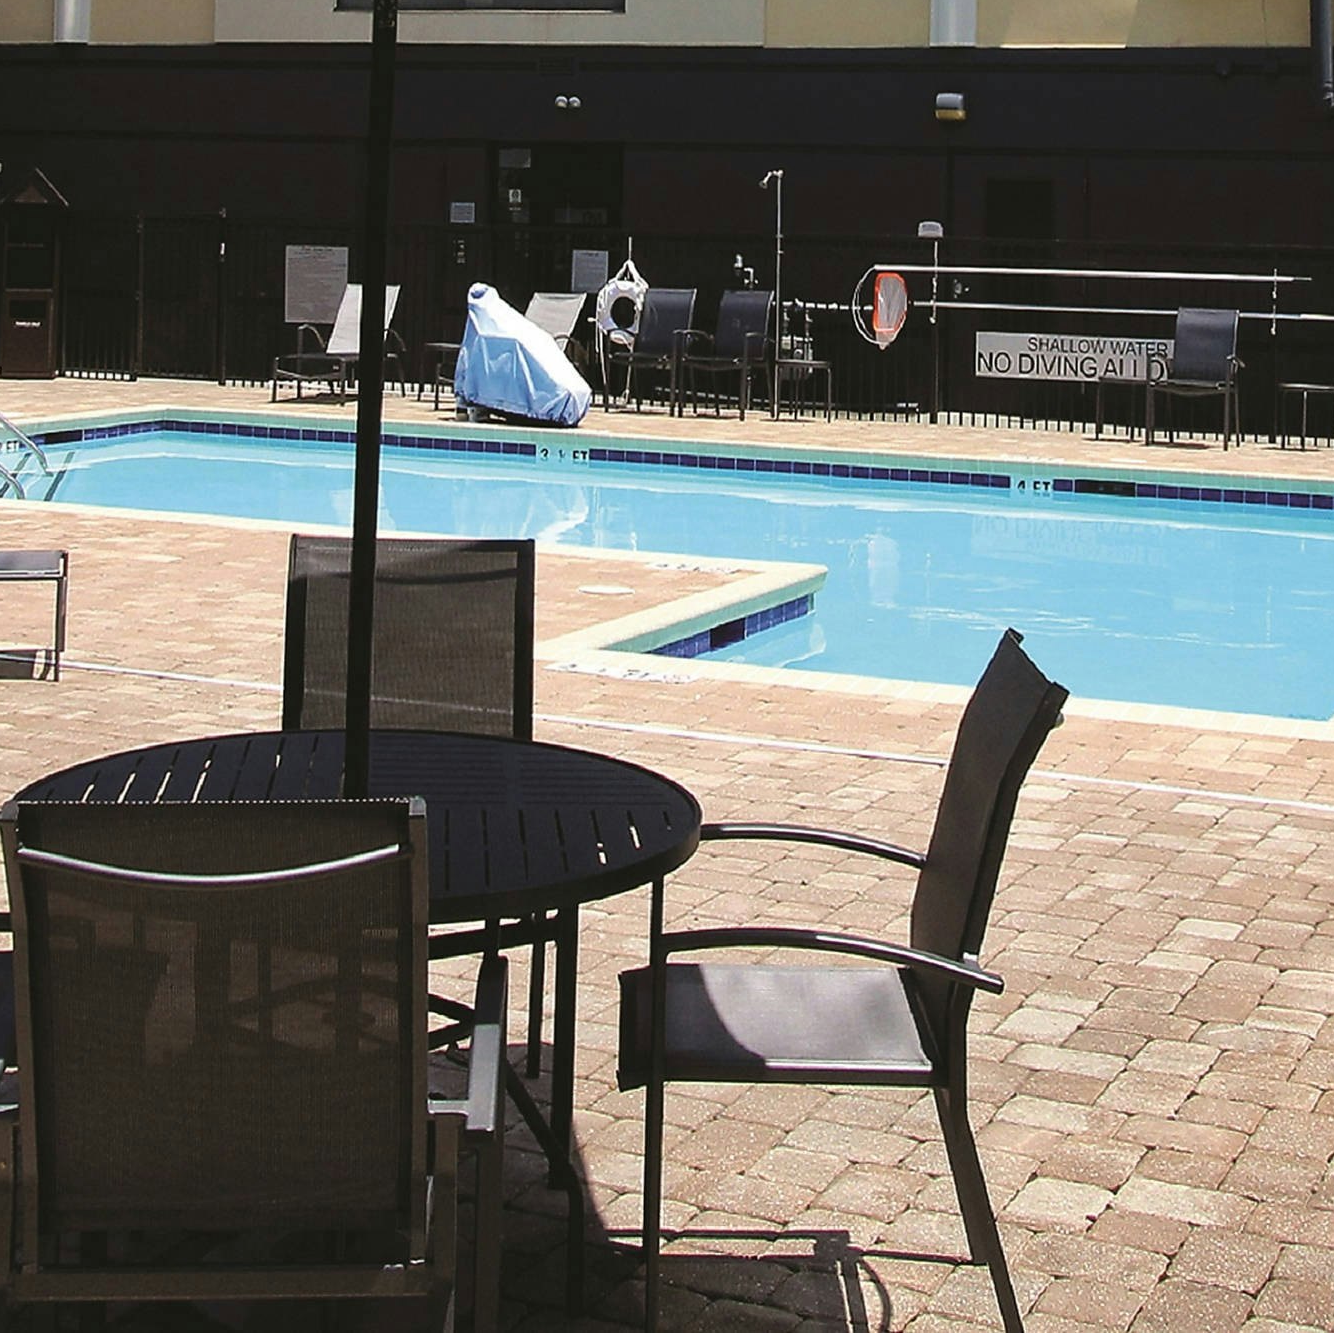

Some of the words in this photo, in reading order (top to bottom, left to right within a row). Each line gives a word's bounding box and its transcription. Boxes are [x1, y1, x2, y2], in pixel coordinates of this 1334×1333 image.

[1027, 336, 1105, 354] SHALLOW
[1110, 340, 1168, 358] WATER
[977, 351, 1011, 373] NO
[1018, 353, 1098, 379] DIVING
